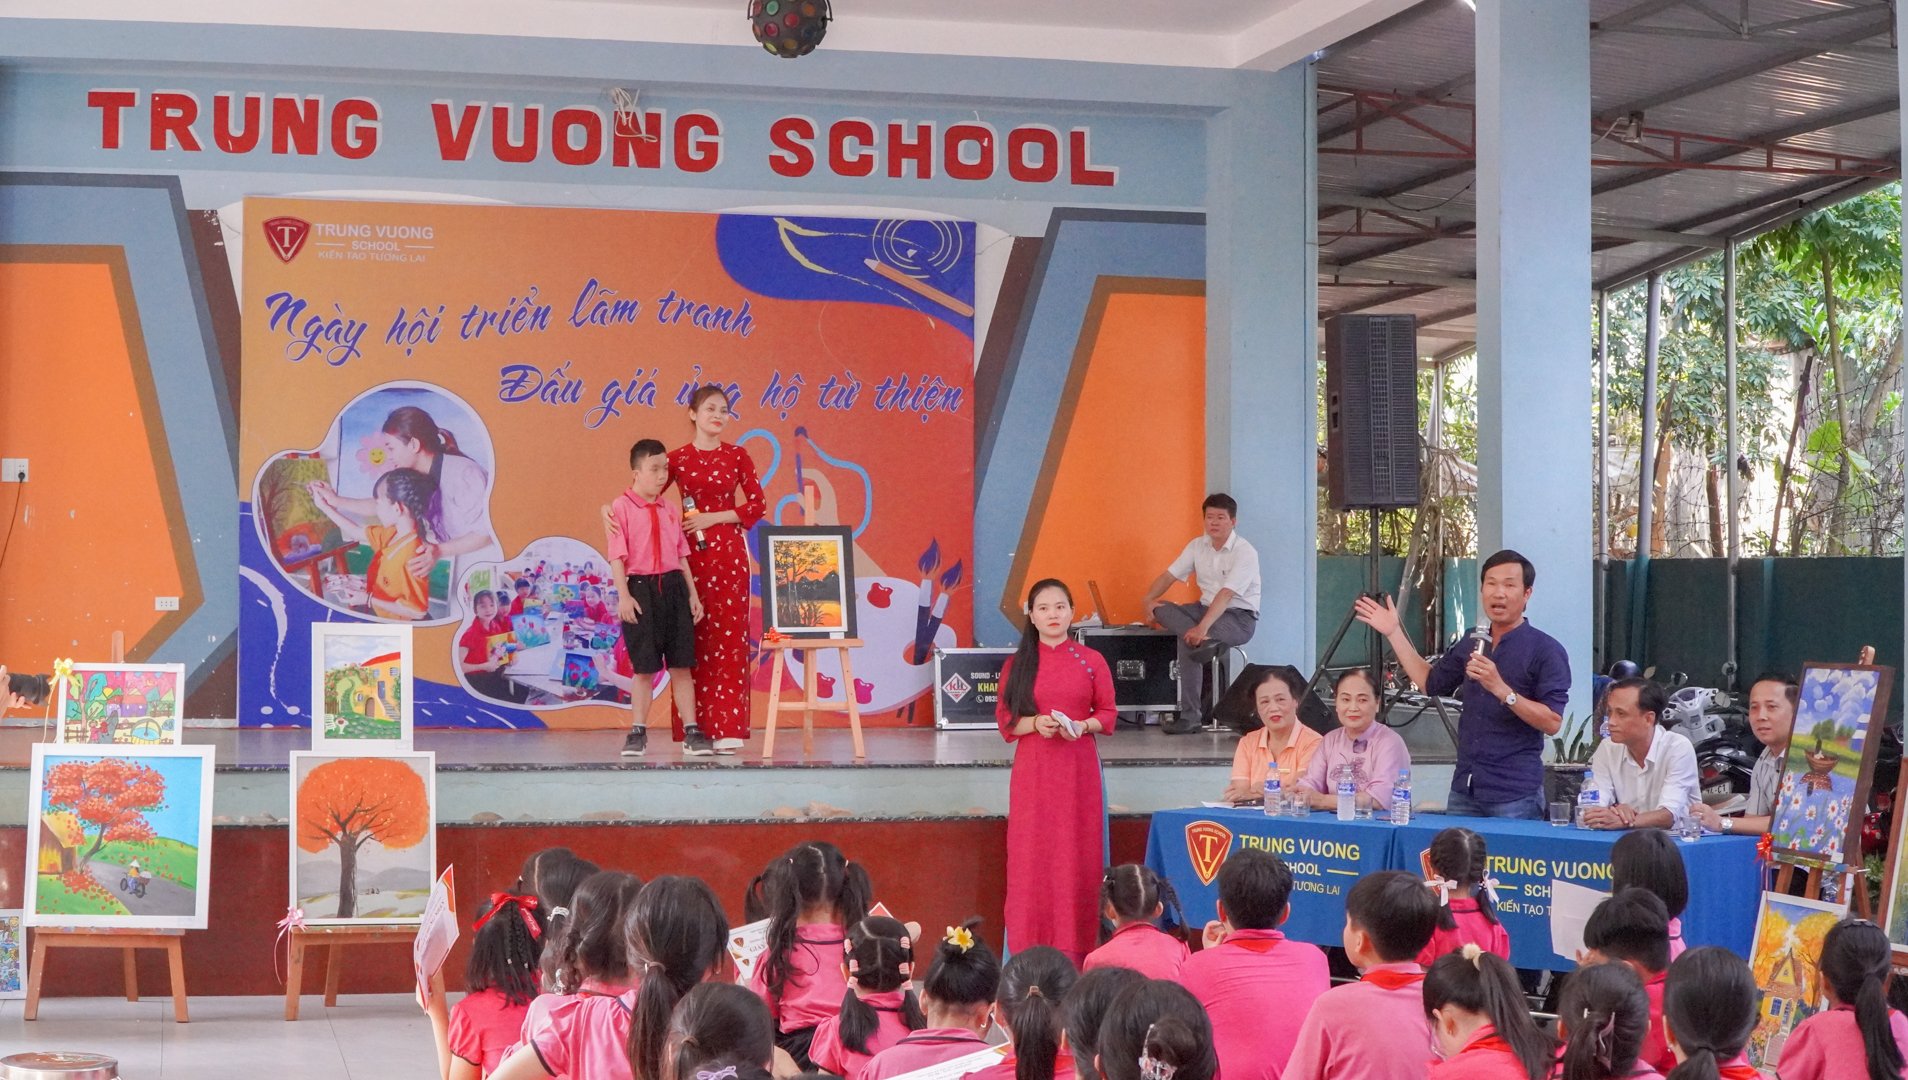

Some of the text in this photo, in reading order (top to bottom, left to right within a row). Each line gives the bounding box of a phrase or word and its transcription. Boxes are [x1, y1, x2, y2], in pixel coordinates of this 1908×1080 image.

[88, 89, 1118, 186] TRUNG VUONG SCHOOL
[315, 223, 372, 238] TRUNG
[376, 225, 434, 240] VUONG
[351, 240, 401, 252] SCHOOL
[410, 254, 426, 263] LAI
[264, 278, 756, 367] Ngày hội triển lãm tranh
[498, 360, 584, 406] Đấu
[584, 367, 659, 430] giá
[759, 368, 806, 421] hộ
[817, 369, 862, 410] từ
[874, 371, 964, 423] thiện
[970, 672, 991, 680] SOUND
[1238, 834, 1361, 861] TRUNG VUONG
[1283, 862, 1322, 876] HOOL
[1486, 855, 1547, 877] TRUNG
[1326, 883, 1340, 896] LAI
[1522, 903, 1544, 918] TẠO
